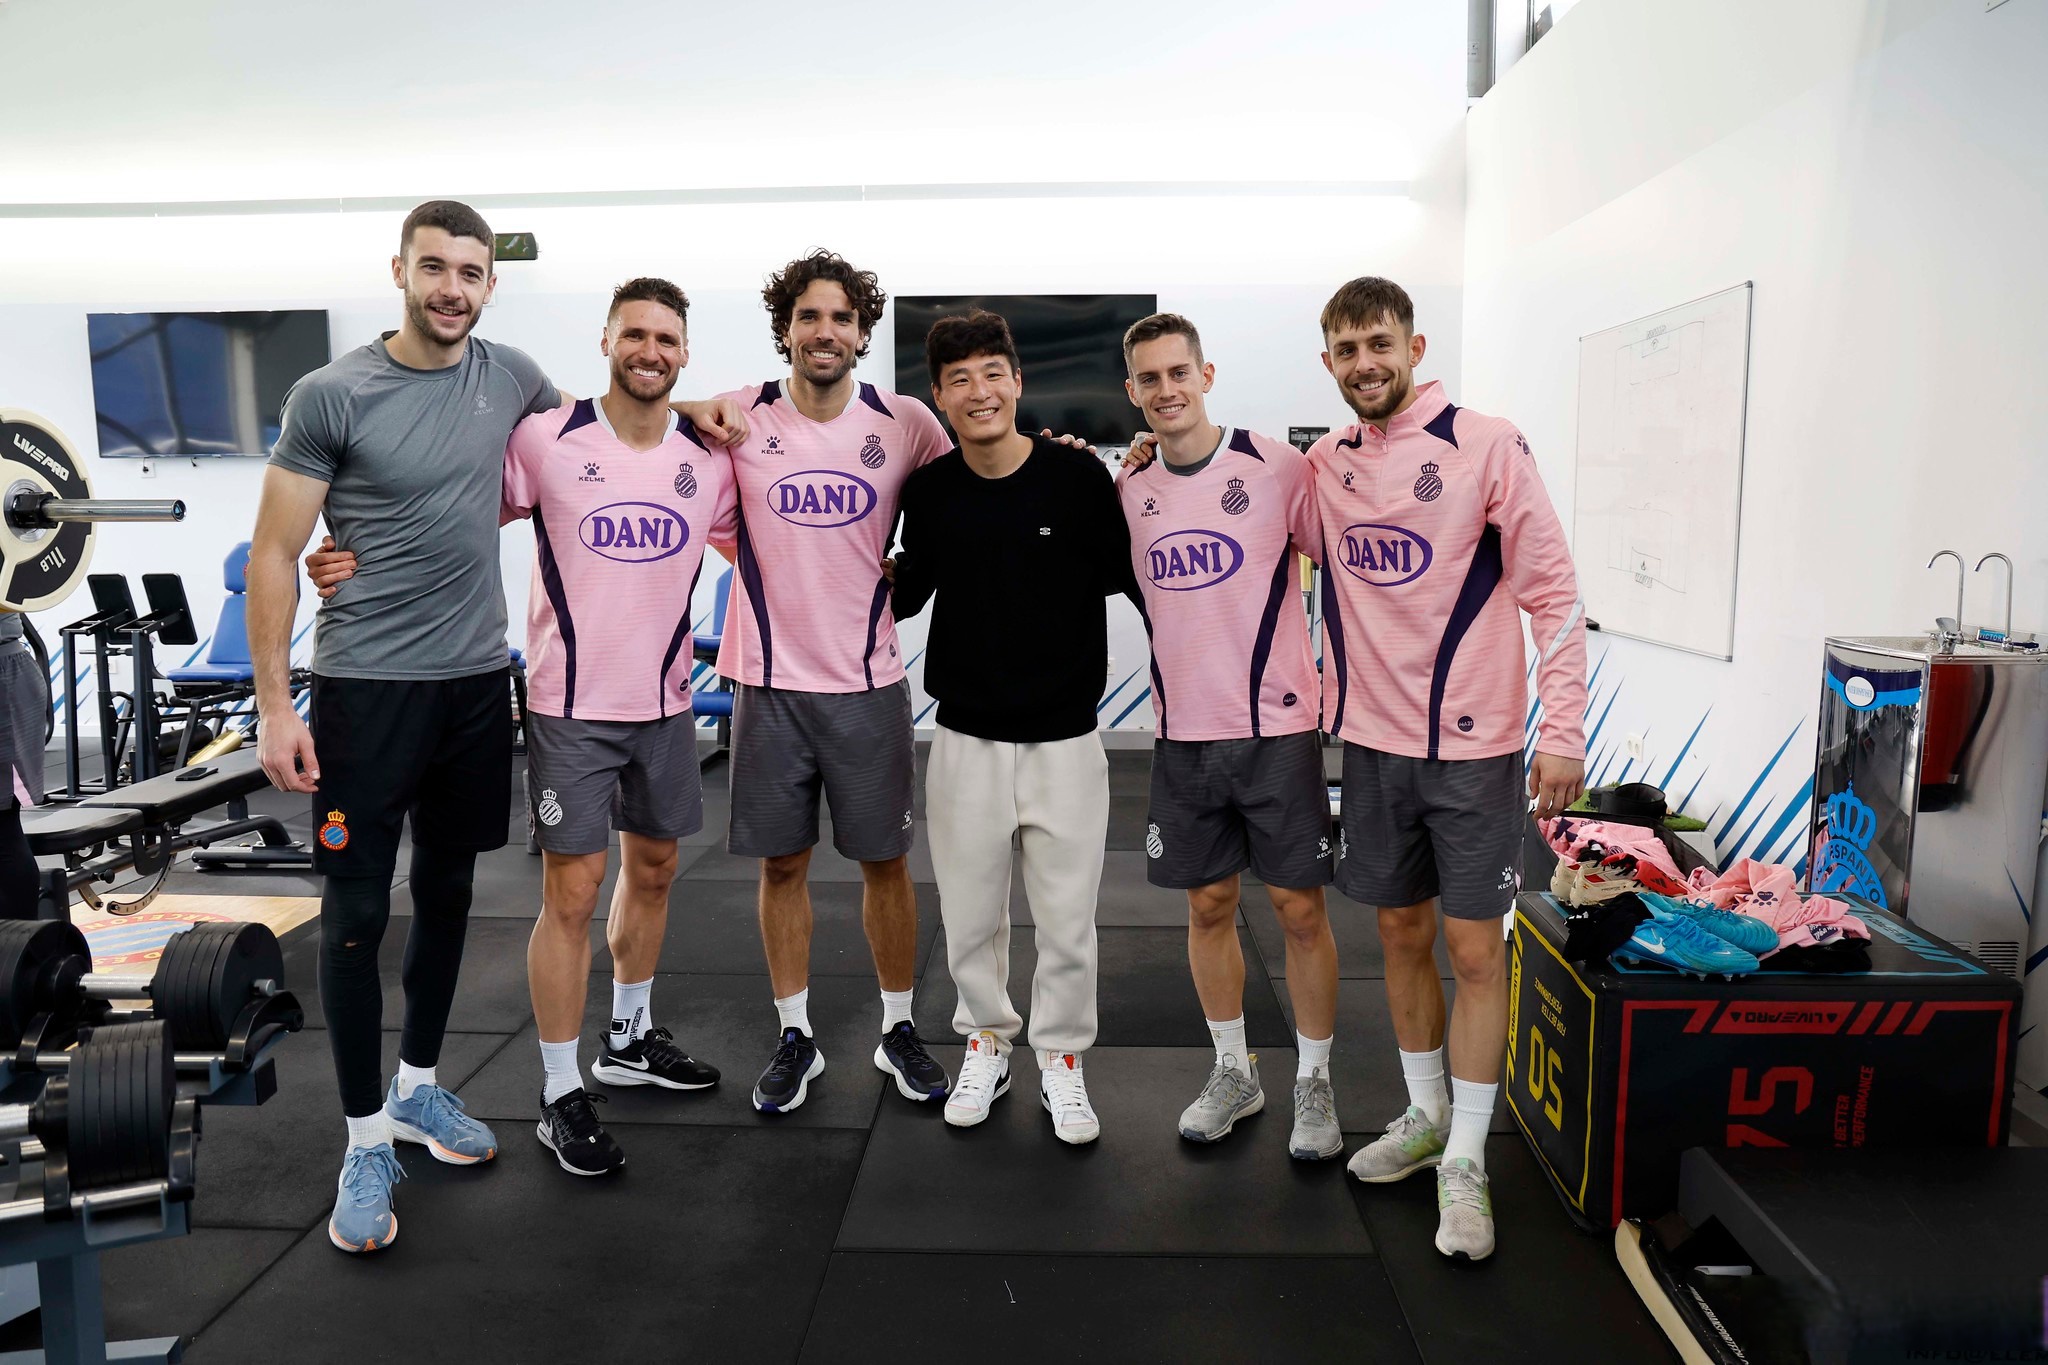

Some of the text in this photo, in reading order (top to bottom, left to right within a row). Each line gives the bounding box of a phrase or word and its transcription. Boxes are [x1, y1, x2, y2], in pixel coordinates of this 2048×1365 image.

[474, 407, 495, 416] KELME
[13, 433, 70, 482] LIVEPRO
[779, 484, 858, 515] DANI
[592, 516, 675, 549] DANI
[1150, 541, 1224, 580] DANI
[1345, 536, 1412, 573] DANI
[1497, 879, 1514, 890] KELM
[1830, 844, 1880, 904] ESPANYO
[1534, 976, 1563, 1015] PERFORMANCE
[1541, 1002, 1567, 1037] FOR BETTER
[1745, 1012, 1823, 1024] LIVEPRO
[1528, 1024, 1563, 1132] 50
[1834, 1094, 1850, 1142] BETTER
